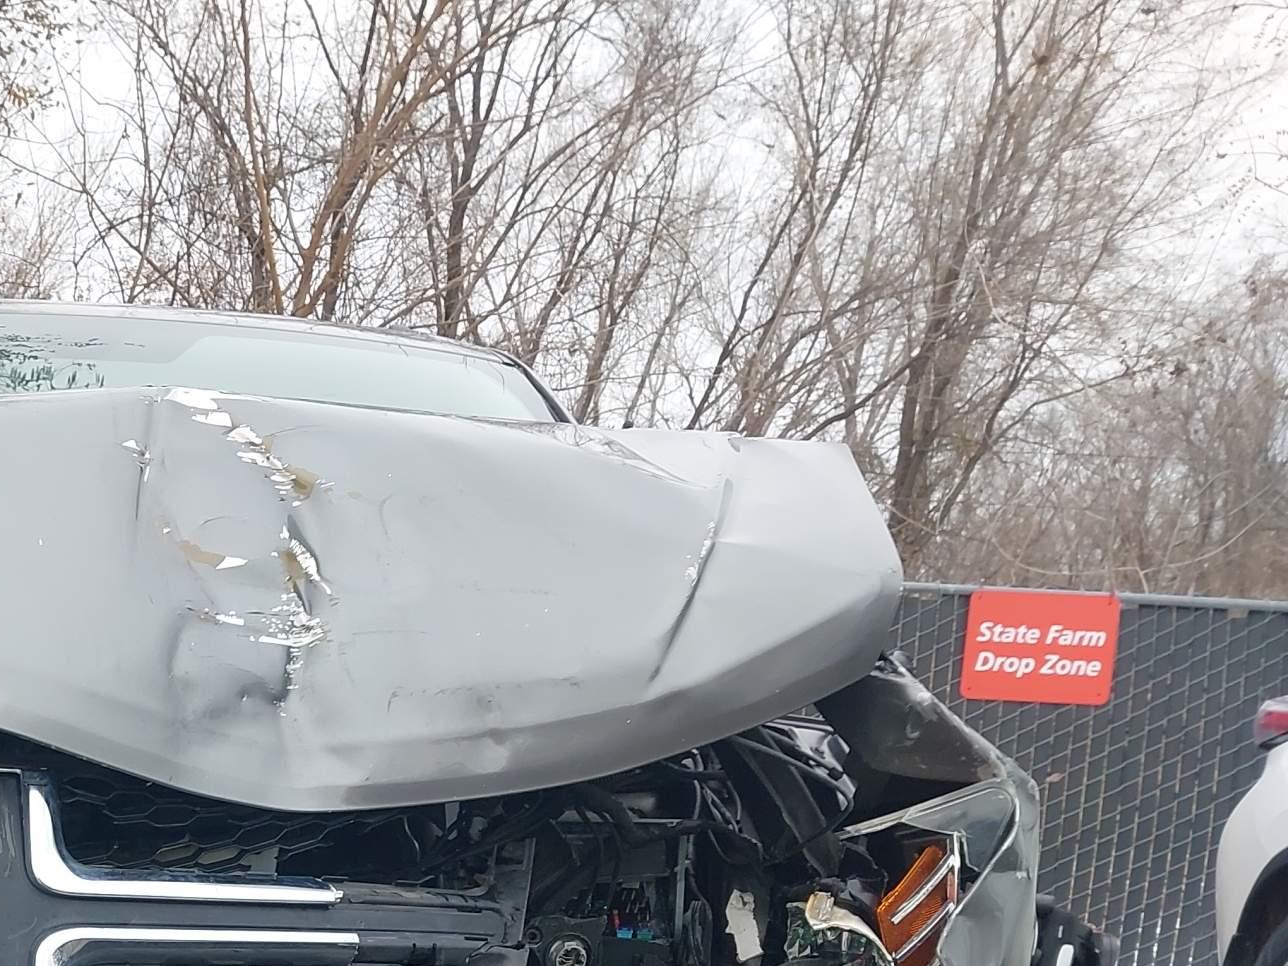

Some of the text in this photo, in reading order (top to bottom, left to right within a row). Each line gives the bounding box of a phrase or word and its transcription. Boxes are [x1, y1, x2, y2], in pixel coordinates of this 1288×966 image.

[976, 621, 1107, 647] State Farm
[974, 651, 1102, 678] Drop Zone
